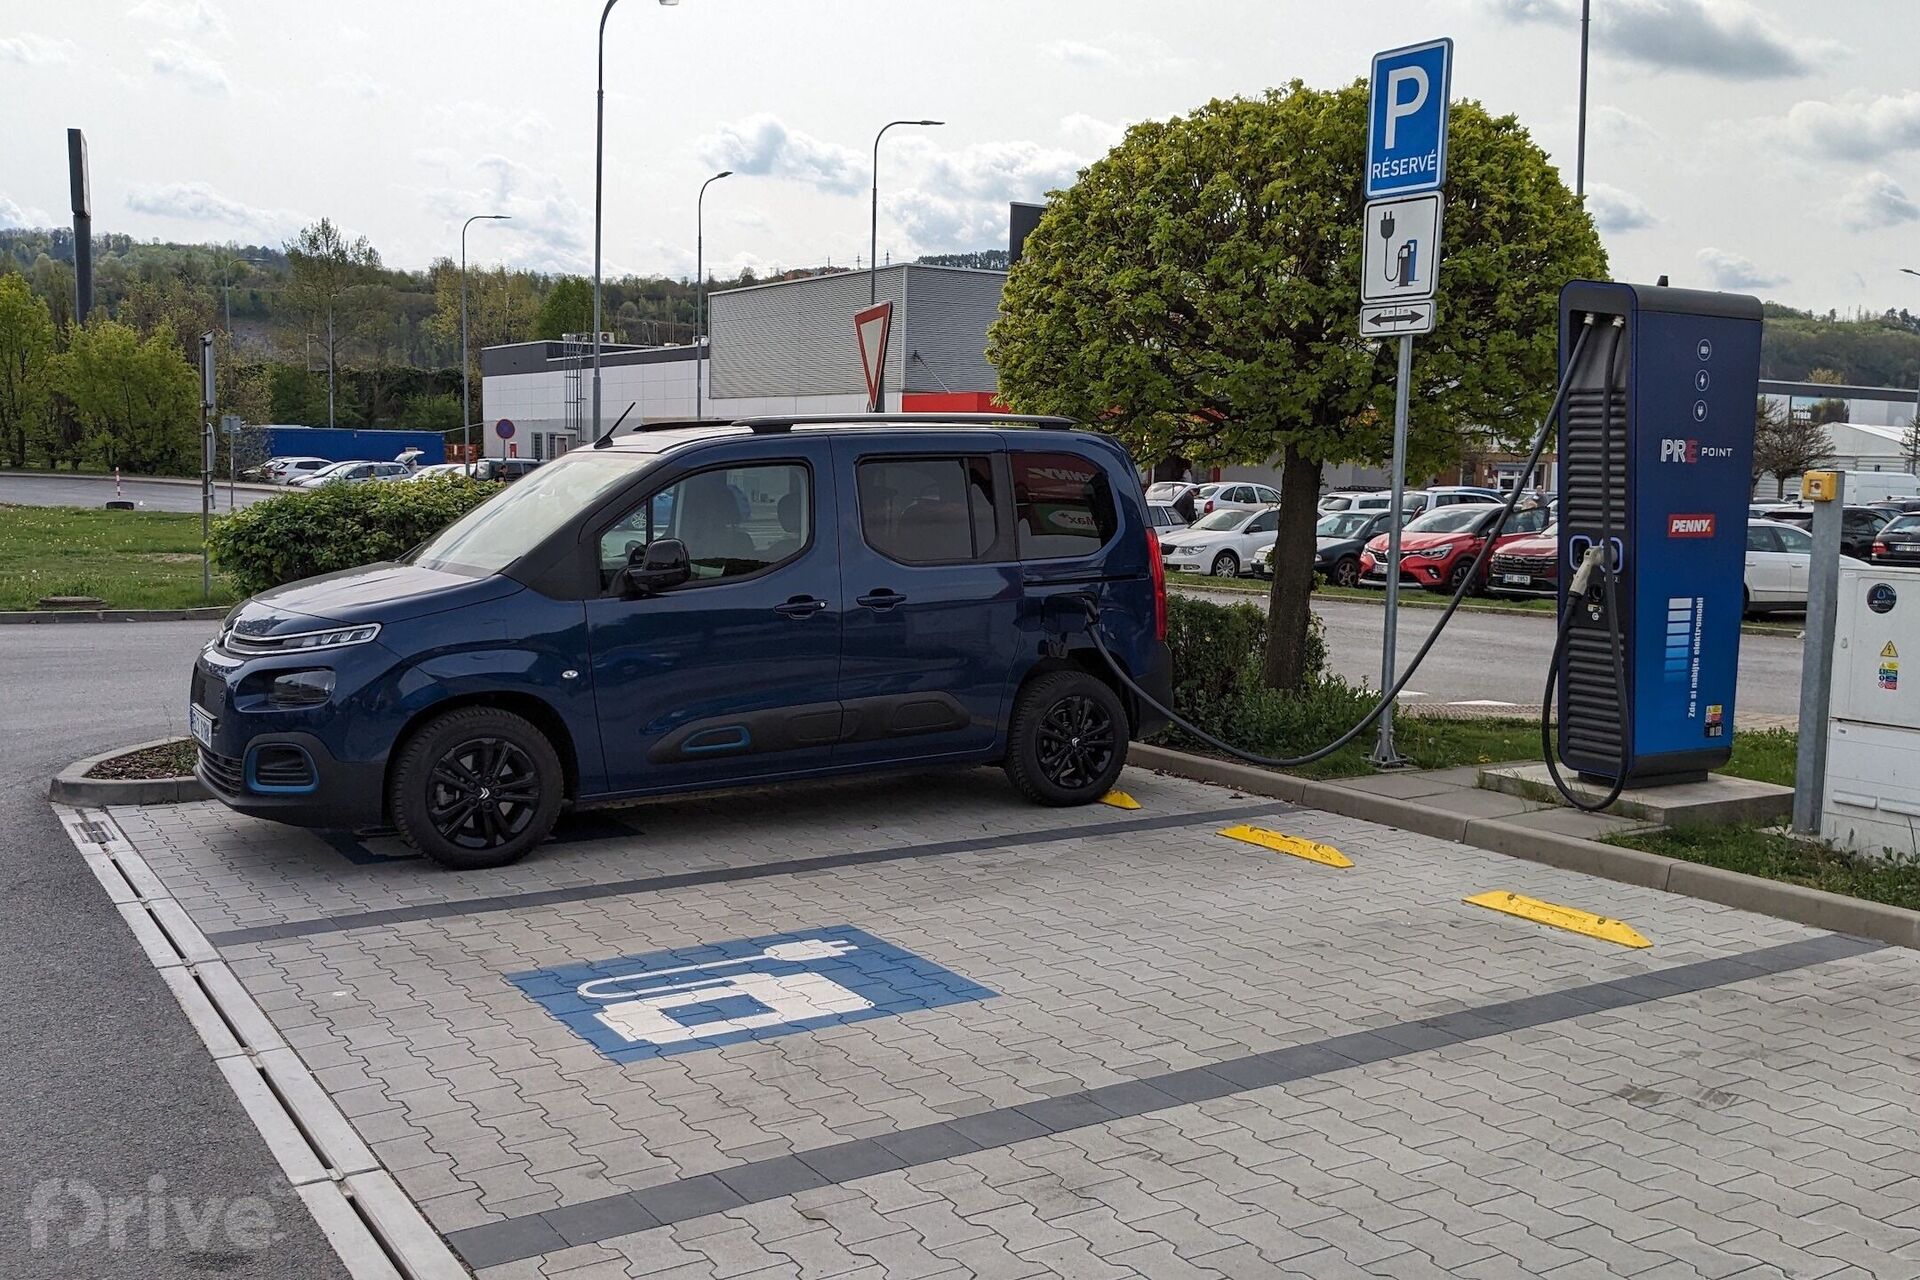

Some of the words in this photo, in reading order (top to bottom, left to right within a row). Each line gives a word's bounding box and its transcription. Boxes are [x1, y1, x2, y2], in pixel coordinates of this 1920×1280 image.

[1384, 66, 1429, 150] P
[1372, 149, 1437, 179] RÉSERVÉ
[1661, 438, 1697, 463] PRE
[1701, 447, 1733, 457] POINT
[1693, 597, 1704, 655] elektromobil
[1691, 657, 1699, 688] nabijte
[1688, 701, 1696, 718] Zde
[1690, 690, 1697, 699] si
